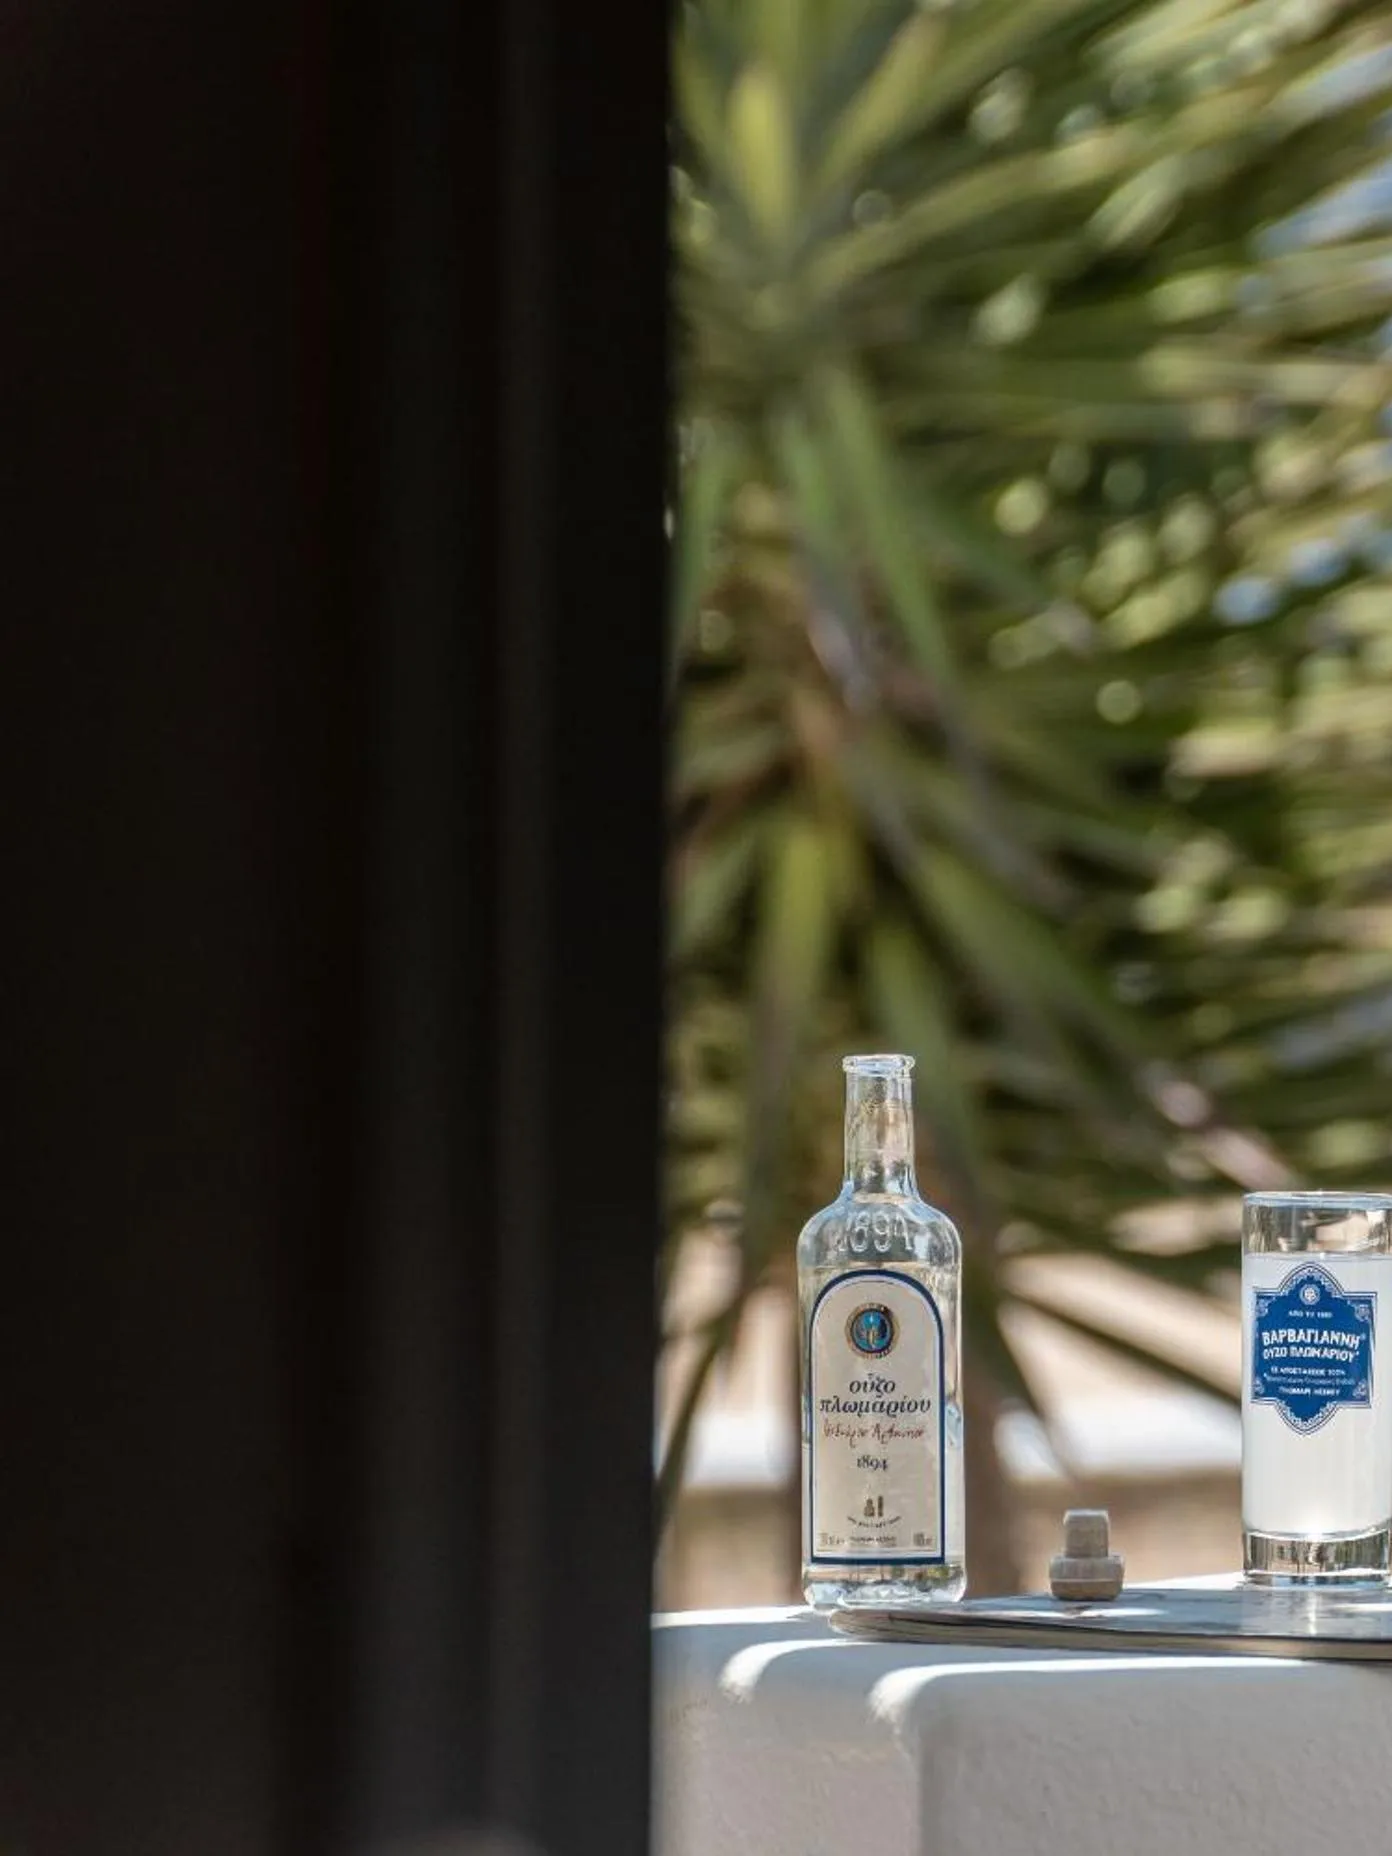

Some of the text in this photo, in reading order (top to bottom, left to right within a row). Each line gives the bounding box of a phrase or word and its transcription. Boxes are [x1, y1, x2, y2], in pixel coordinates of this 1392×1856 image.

[1262, 1328, 1360, 1350] ΒΑΡΒΑΓΙΑΝΝΗ
[1263, 1345, 1354, 1363] ΟΥΖΟ ΠΛΩΜΑΡΙΟΥ
